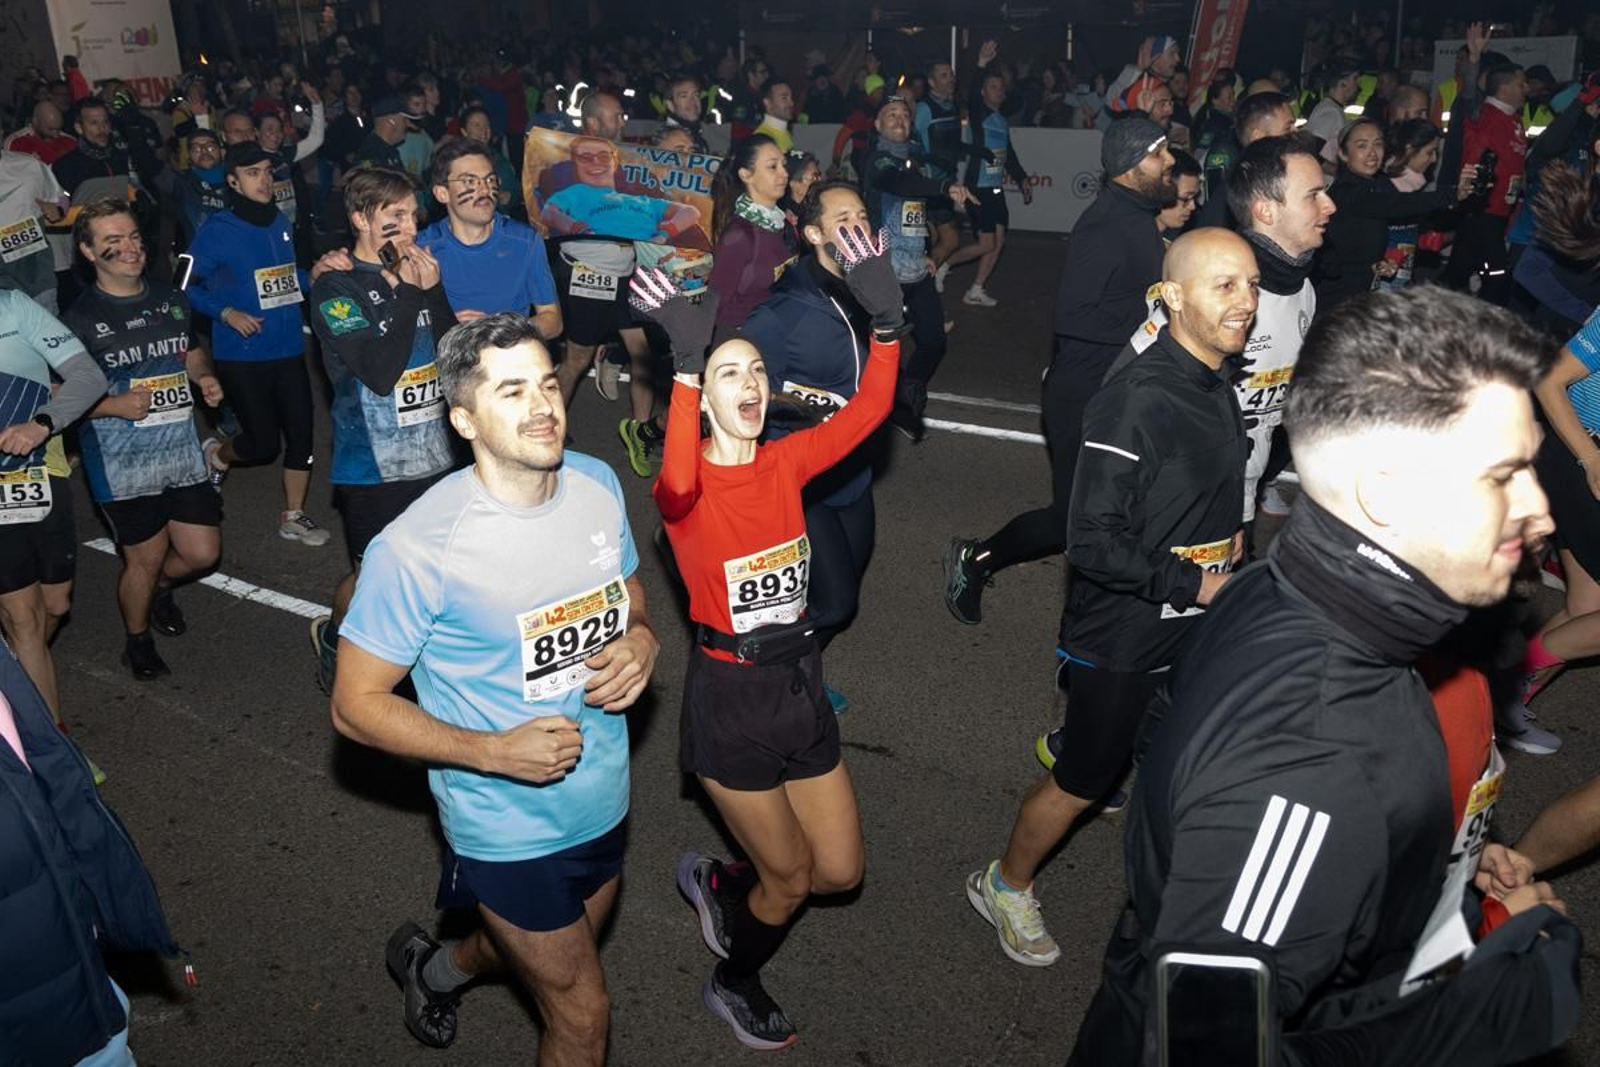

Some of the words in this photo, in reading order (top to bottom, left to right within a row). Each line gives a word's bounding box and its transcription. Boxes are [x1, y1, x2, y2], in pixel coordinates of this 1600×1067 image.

[624, 165, 656, 187] TI,
[1, 227, 39, 249] 6865
[263, 275, 295, 293] 6158
[577, 273, 612, 286] 4518
[104, 346, 143, 368] SAN
[748, 556, 767, 572] 42
[545, 606, 567, 625] 42
[534, 607, 619, 666] 8929
